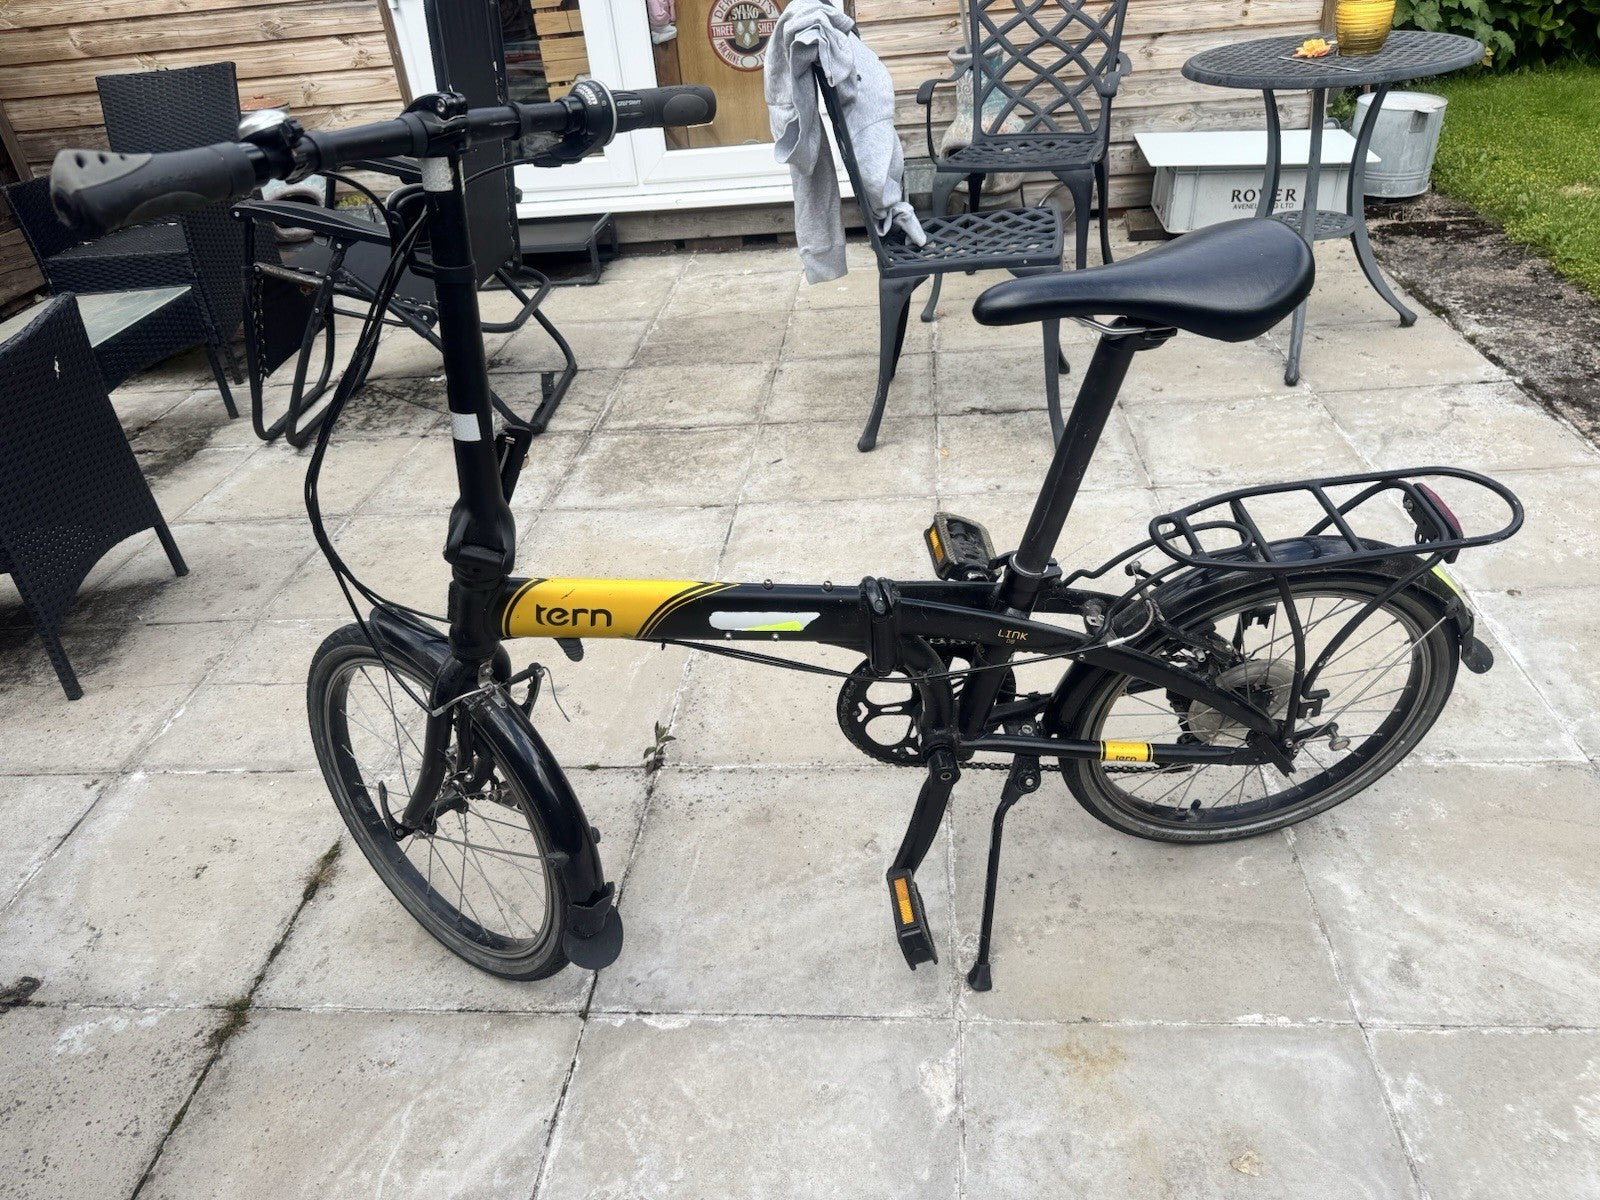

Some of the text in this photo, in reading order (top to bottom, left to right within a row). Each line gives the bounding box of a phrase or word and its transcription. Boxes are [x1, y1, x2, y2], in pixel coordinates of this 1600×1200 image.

[712, 25, 734, 36] THREE
[1231, 188, 1297, 202] ROER
[535, 604, 612, 627] tern
